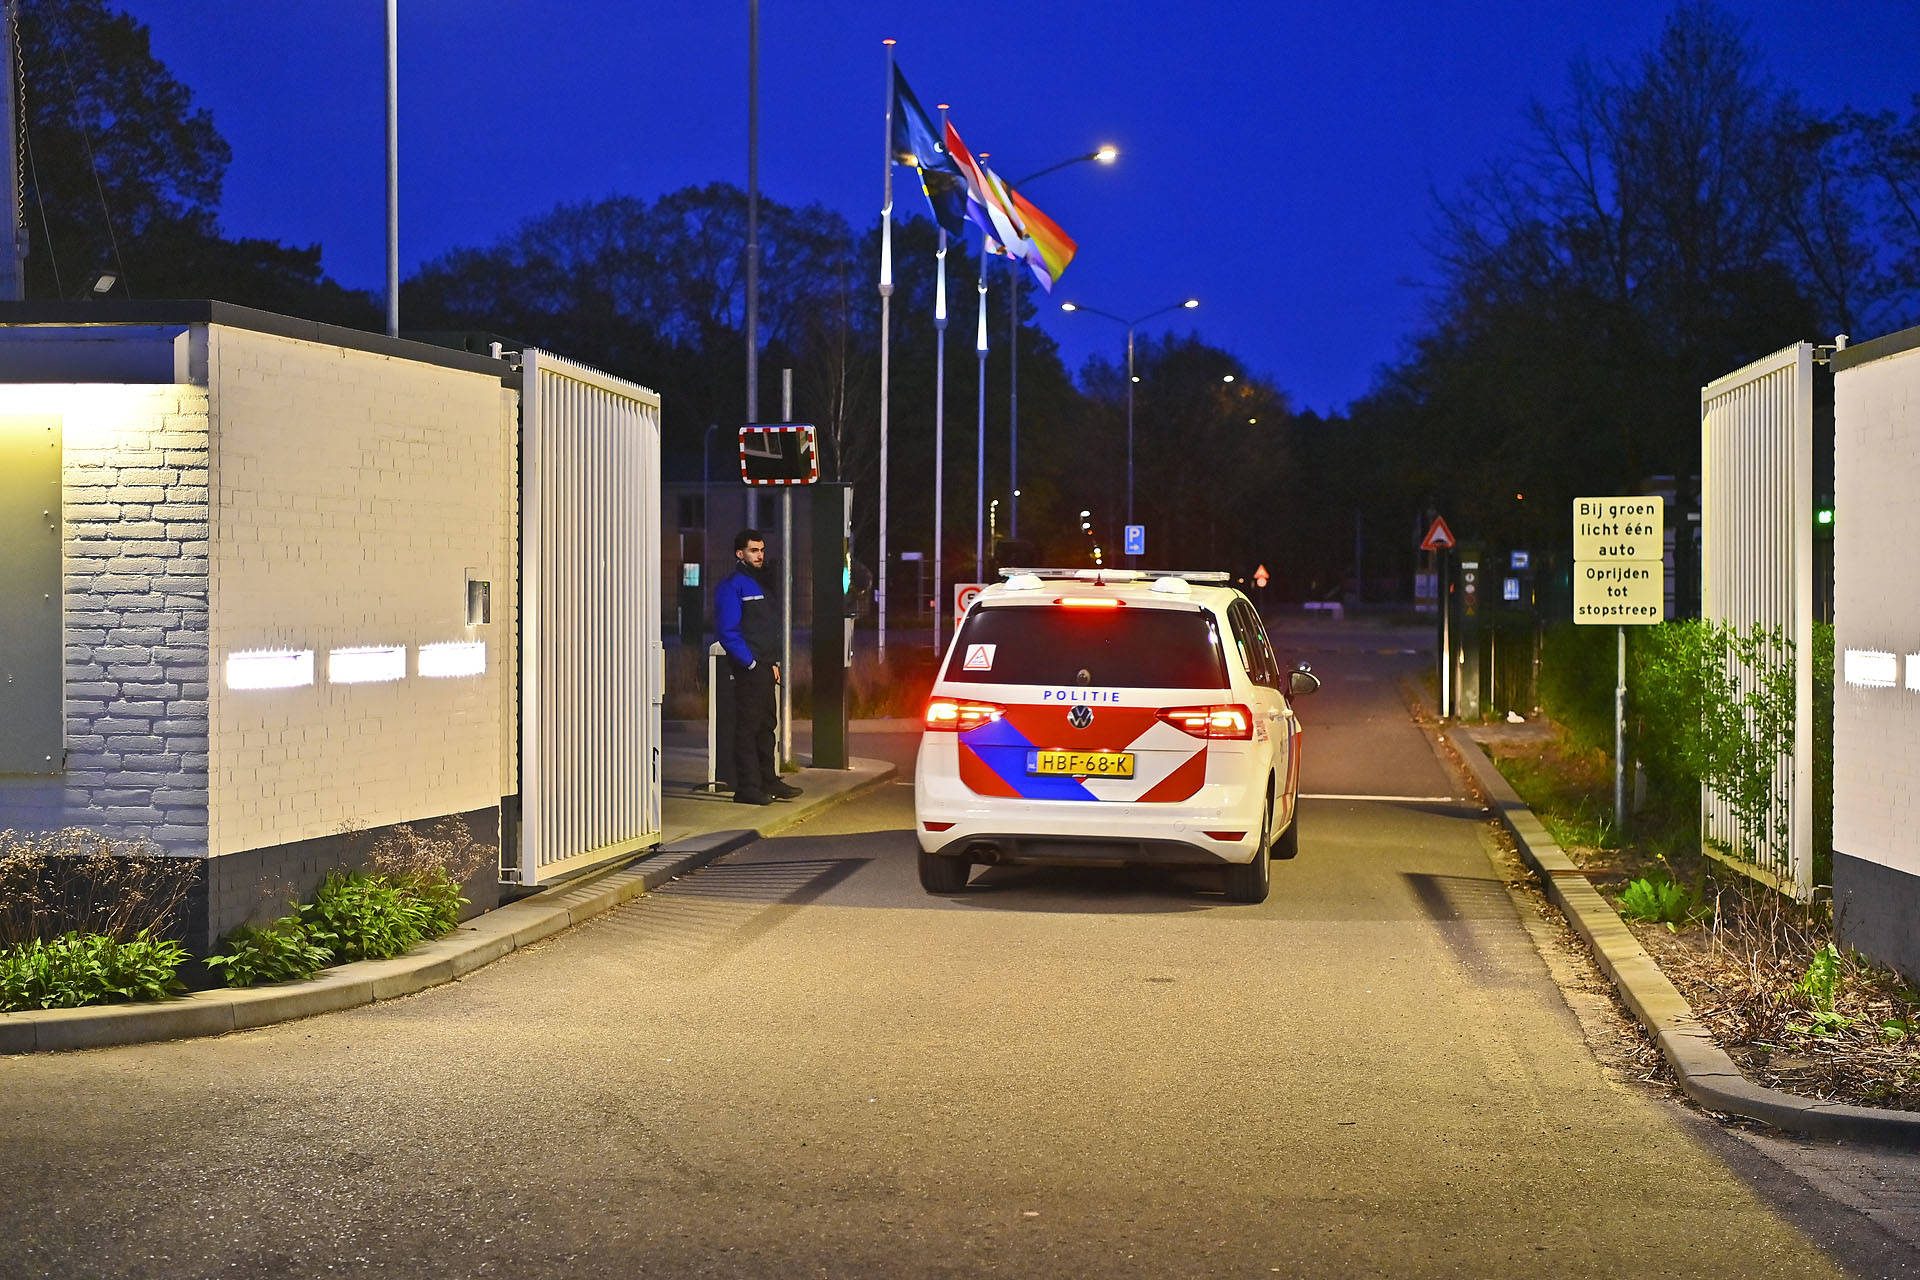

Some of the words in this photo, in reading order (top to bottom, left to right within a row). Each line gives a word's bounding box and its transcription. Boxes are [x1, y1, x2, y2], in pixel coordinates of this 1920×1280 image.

[1580, 503, 1602, 519] Bij
[1609, 505, 1655, 519] groen
[1581, 523, 1619, 535] licht
[1625, 523, 1653, 535] één
[1599, 544, 1635, 556] auto
[1586, 568, 1649, 582] Oprijden
[1607, 586, 1628, 597] tot
[1579, 604, 1657, 617] stopstreep
[1043, 690, 1120, 702] POLITIE
[1043, 755, 1128, 773] HBF-68-K
